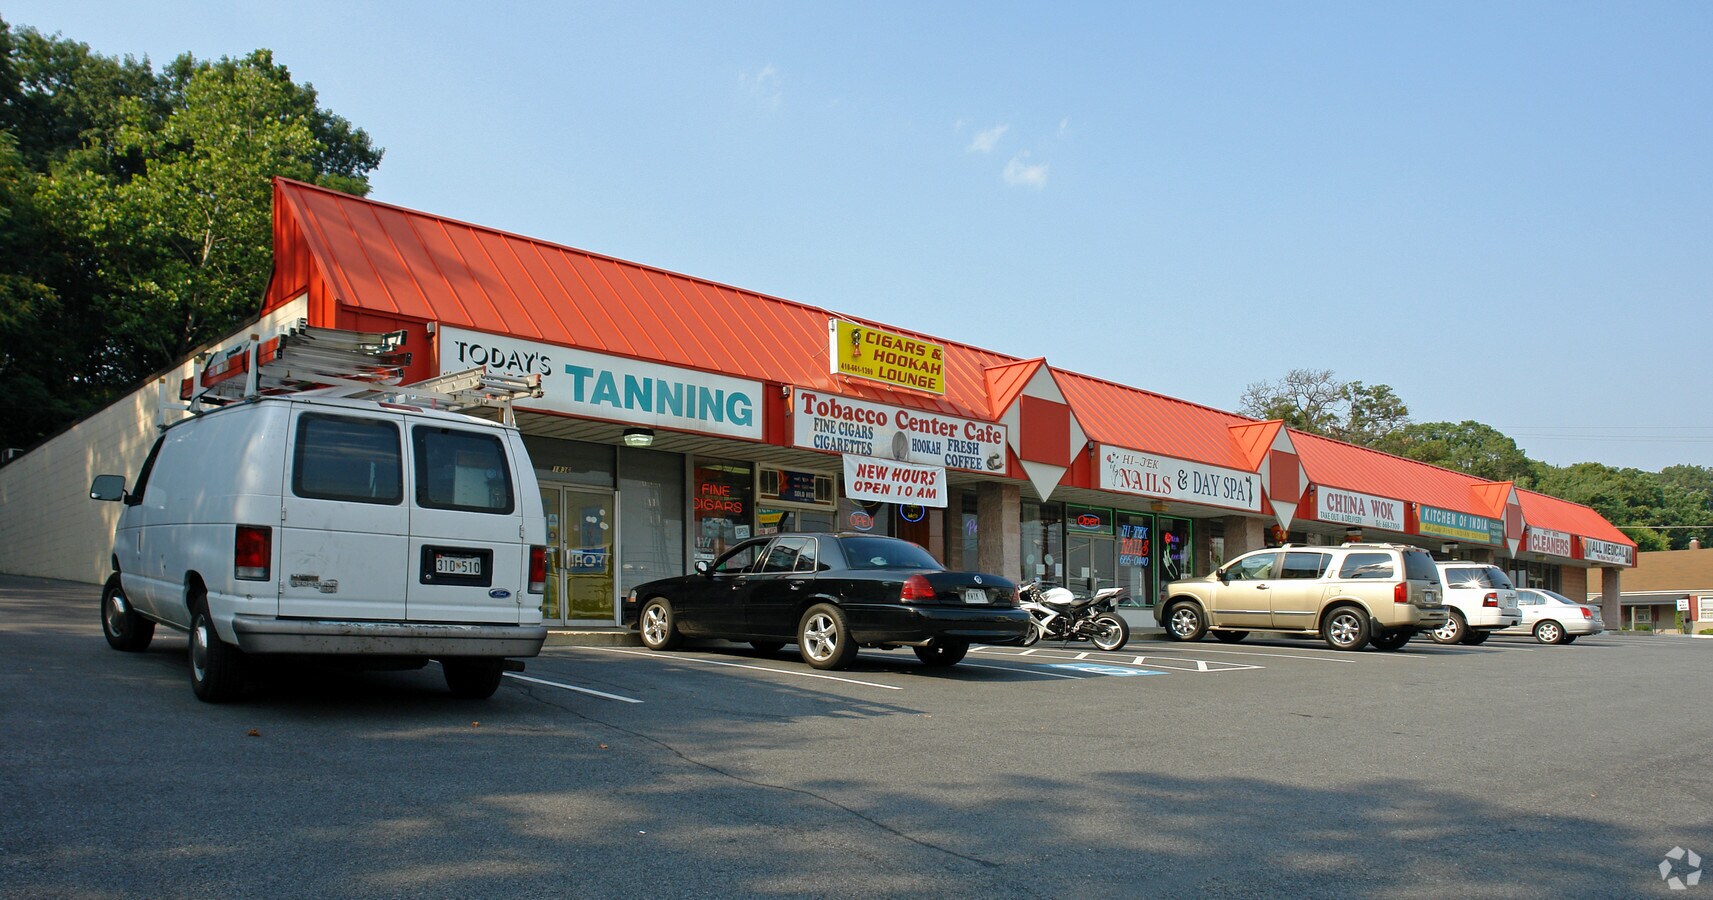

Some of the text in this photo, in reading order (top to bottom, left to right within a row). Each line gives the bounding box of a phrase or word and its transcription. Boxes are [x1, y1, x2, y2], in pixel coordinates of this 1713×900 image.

[865, 331, 942, 360] CIGARS &
[454, 340, 552, 376] TODAY'S
[873, 349, 941, 376] HOOKAH
[878, 366, 936, 389] LOUNGE
[564, 364, 753, 427] TANNING
[801, 392, 1002, 445] Tobacco Center Cafe
[813, 417, 874, 440] FINE CIGARS
[813, 434, 873, 456] CIGARETTES
[911, 438, 941, 455] HOOKAH
[947, 438, 979, 456] FRESH
[945, 453, 982, 470] COFFEE
[856, 463, 936, 486] NEW HOURS
[1120, 467, 1246, 502] NAILS & DAY SPA
[701, 483, 730, 497] FINE
[853, 482, 937, 499] OPEN 10 AM
[693, 497, 743, 513] CIGARS
[1326, 492, 1395, 521] CHINA WOK
[850, 514, 874, 527] OPEN
[1078, 515, 1101, 527] Open
[1320, 511, 1330, 520] TAKE
[1331, 512, 1339, 521] OUT
[1344, 514, 1362, 524] DELIVERY
[1424, 508, 1456, 525] KITCHEN
[1469, 517, 1488, 531] INDIA
[1120, 537, 1149, 557] NAILS
[1532, 533, 1569, 555] CLEANERS
[1591, 540, 1625, 557] ALL MEDICAL
[462, 560, 480, 574] 510
